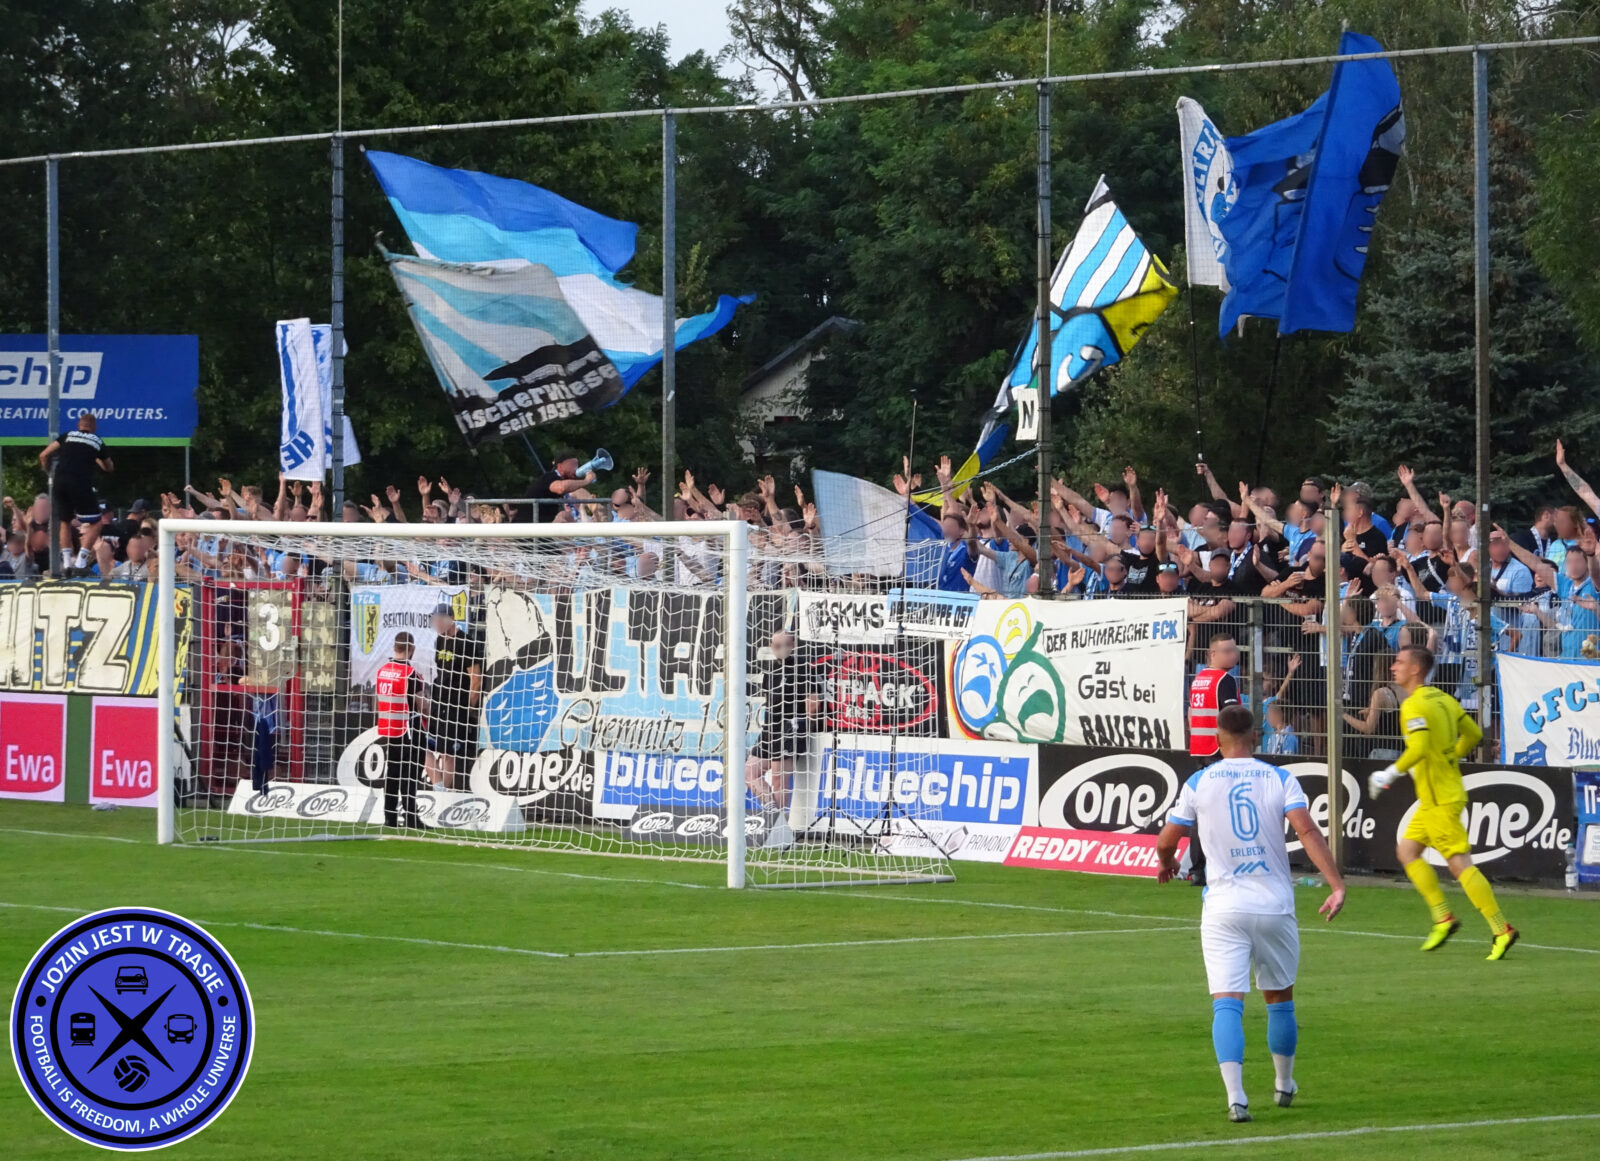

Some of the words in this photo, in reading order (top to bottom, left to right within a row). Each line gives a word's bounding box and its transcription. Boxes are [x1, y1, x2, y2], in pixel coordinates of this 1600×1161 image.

[0, 357, 93, 393] chp
[0, 407, 60, 419] EATIN
[67, 407, 168, 420] COMPUTERS.
[500, 412, 536, 435] seit
[538, 400, 583, 424] 1934
[1022, 400, 1035, 429] N
[259, 603, 280, 651] 3
[953, 605, 974, 628] OST
[0, 586, 136, 693] ITZ
[1046, 632, 1067, 653] DER
[1071, 623, 1150, 648] RUHMREICHE
[1152, 620, 1179, 640] FCK
[1095, 661, 1111, 675] zu
[379, 682, 393, 695] 107
[1078, 674, 1129, 700] Gast
[1133, 684, 1156, 703] bei
[1523, 678, 1600, 735] CFC-
[6, 744, 55, 783] Ewa
[101, 750, 152, 788] Ewa
[499, 750, 593, 792] one.de
[608, 751, 724, 793] bluec
[1210, 769, 1261, 779] CHEMNITZER
[1262, 769, 1272, 779] FC
[824, 754, 1021, 822] bluechip
[1228, 782, 1259, 841] 6
[1462, 801, 1572, 850] ne.de
[1015, 834, 1099, 863] REDDY
[1095, 841, 1180, 868] KÜCHE
[1230, 846, 1267, 858] ERLBECK
